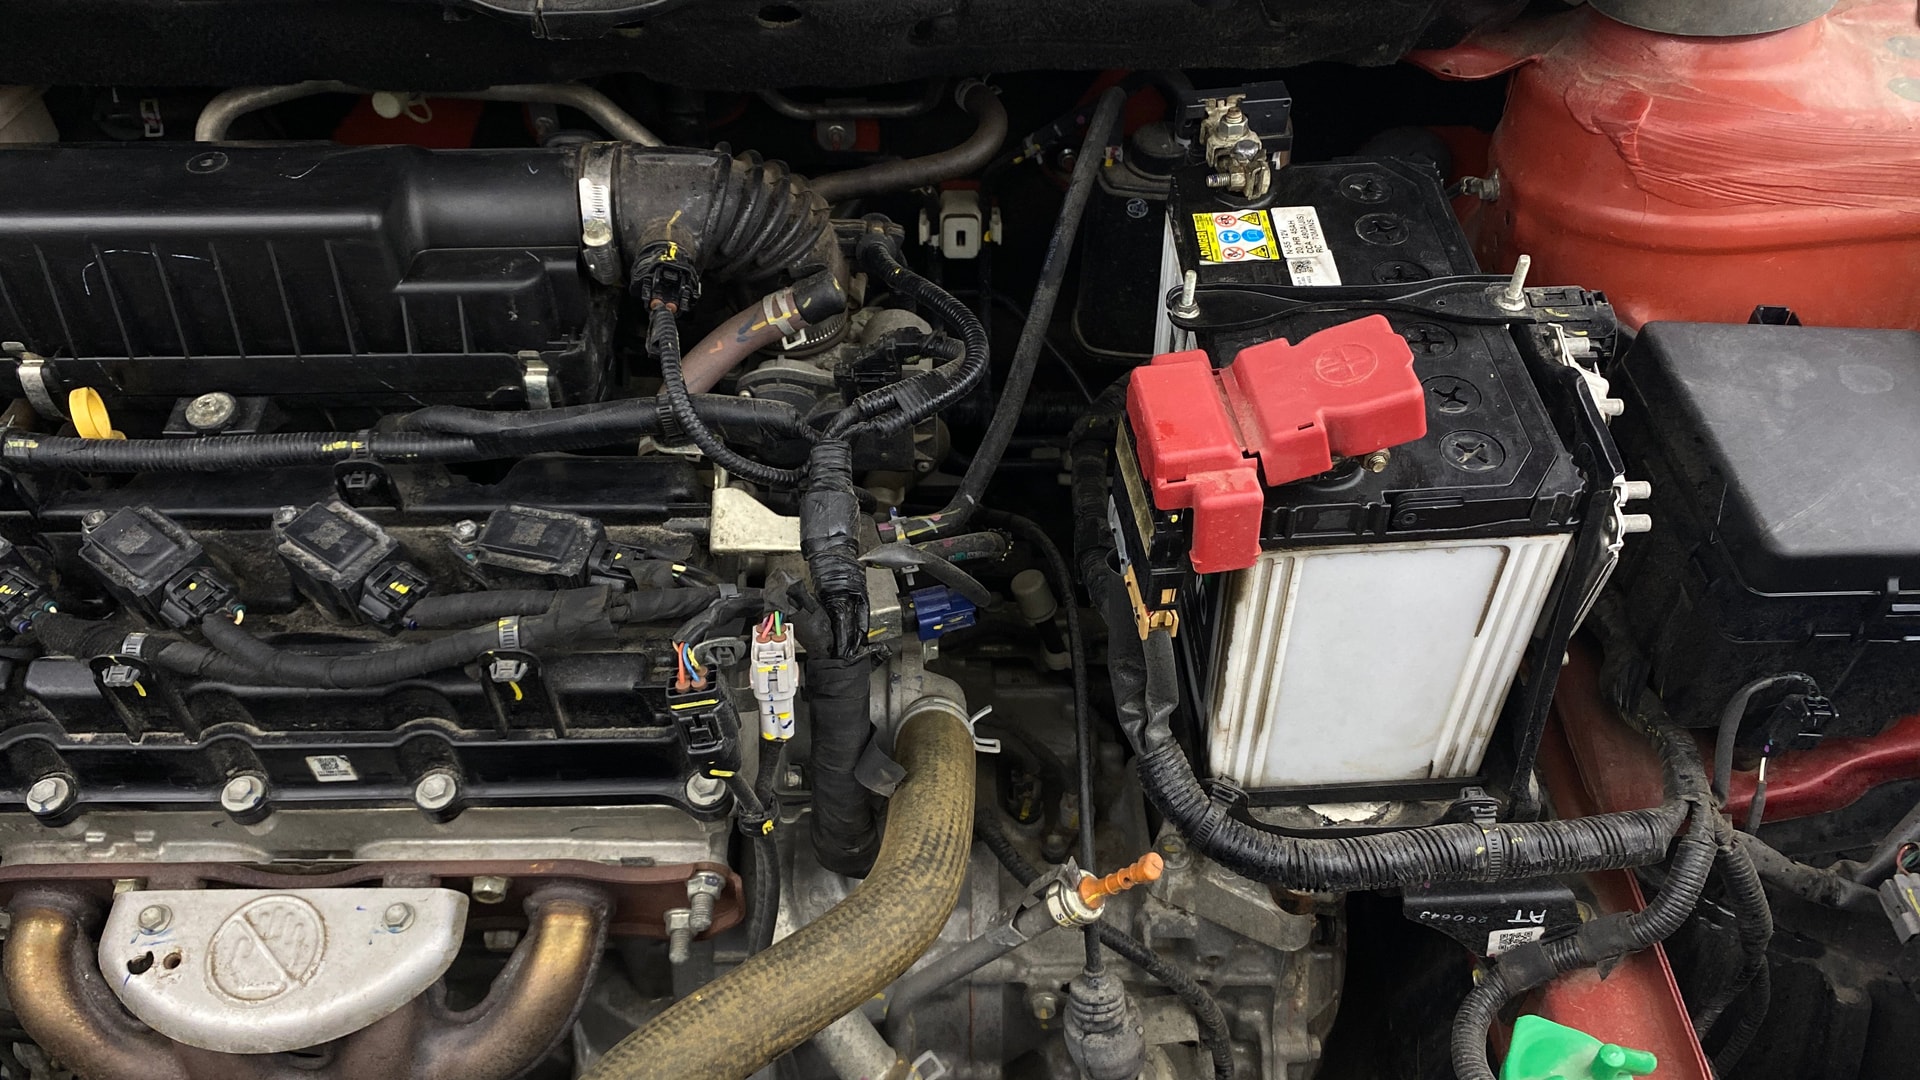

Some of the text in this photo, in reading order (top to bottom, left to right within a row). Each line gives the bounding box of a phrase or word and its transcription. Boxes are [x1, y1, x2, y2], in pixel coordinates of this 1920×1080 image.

[1280, 229, 1289, 239] 12V
[1288, 220, 1304, 254] 20 HR 45AH
[1196, 231, 1211, 256] DANGER
[1305, 241, 1315, 254] CCA
[1314, 244, 1324, 253] RC
[1507, 909, 1547, 923] AT
